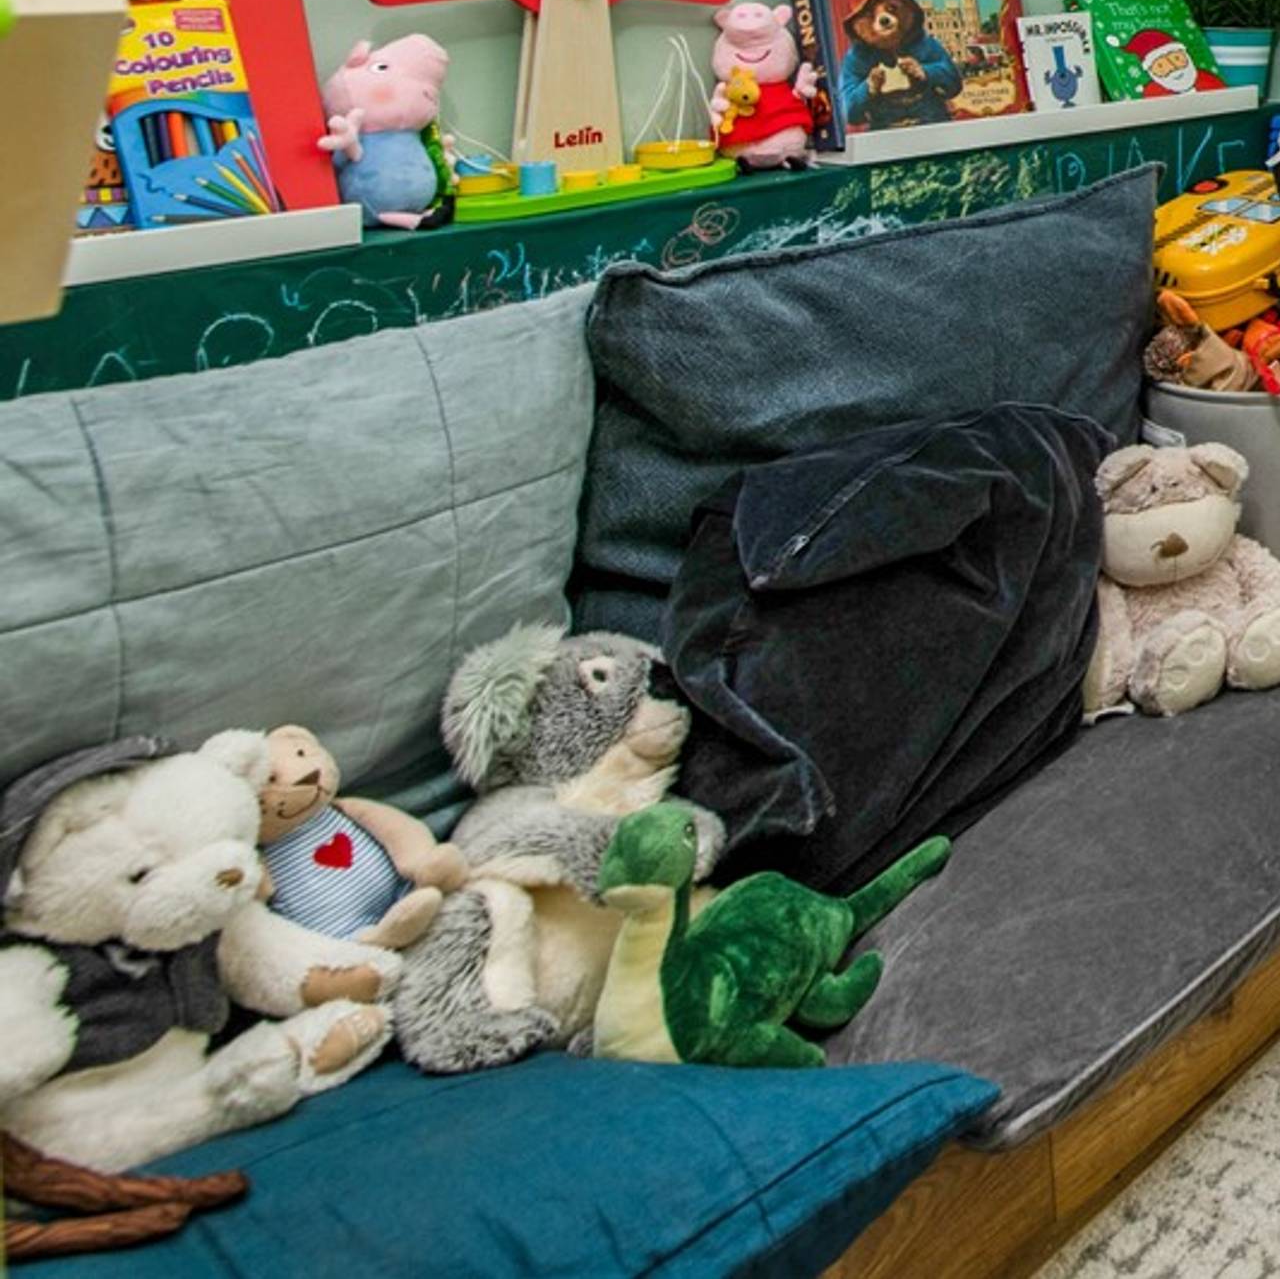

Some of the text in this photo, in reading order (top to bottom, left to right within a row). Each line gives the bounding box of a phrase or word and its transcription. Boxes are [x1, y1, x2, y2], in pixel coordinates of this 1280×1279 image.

[143, 31, 174, 48] 10
[115, 46, 233, 75] Colouring
[146, 69, 235, 95] Pencils
[554, 125, 603, 148] Lelin
